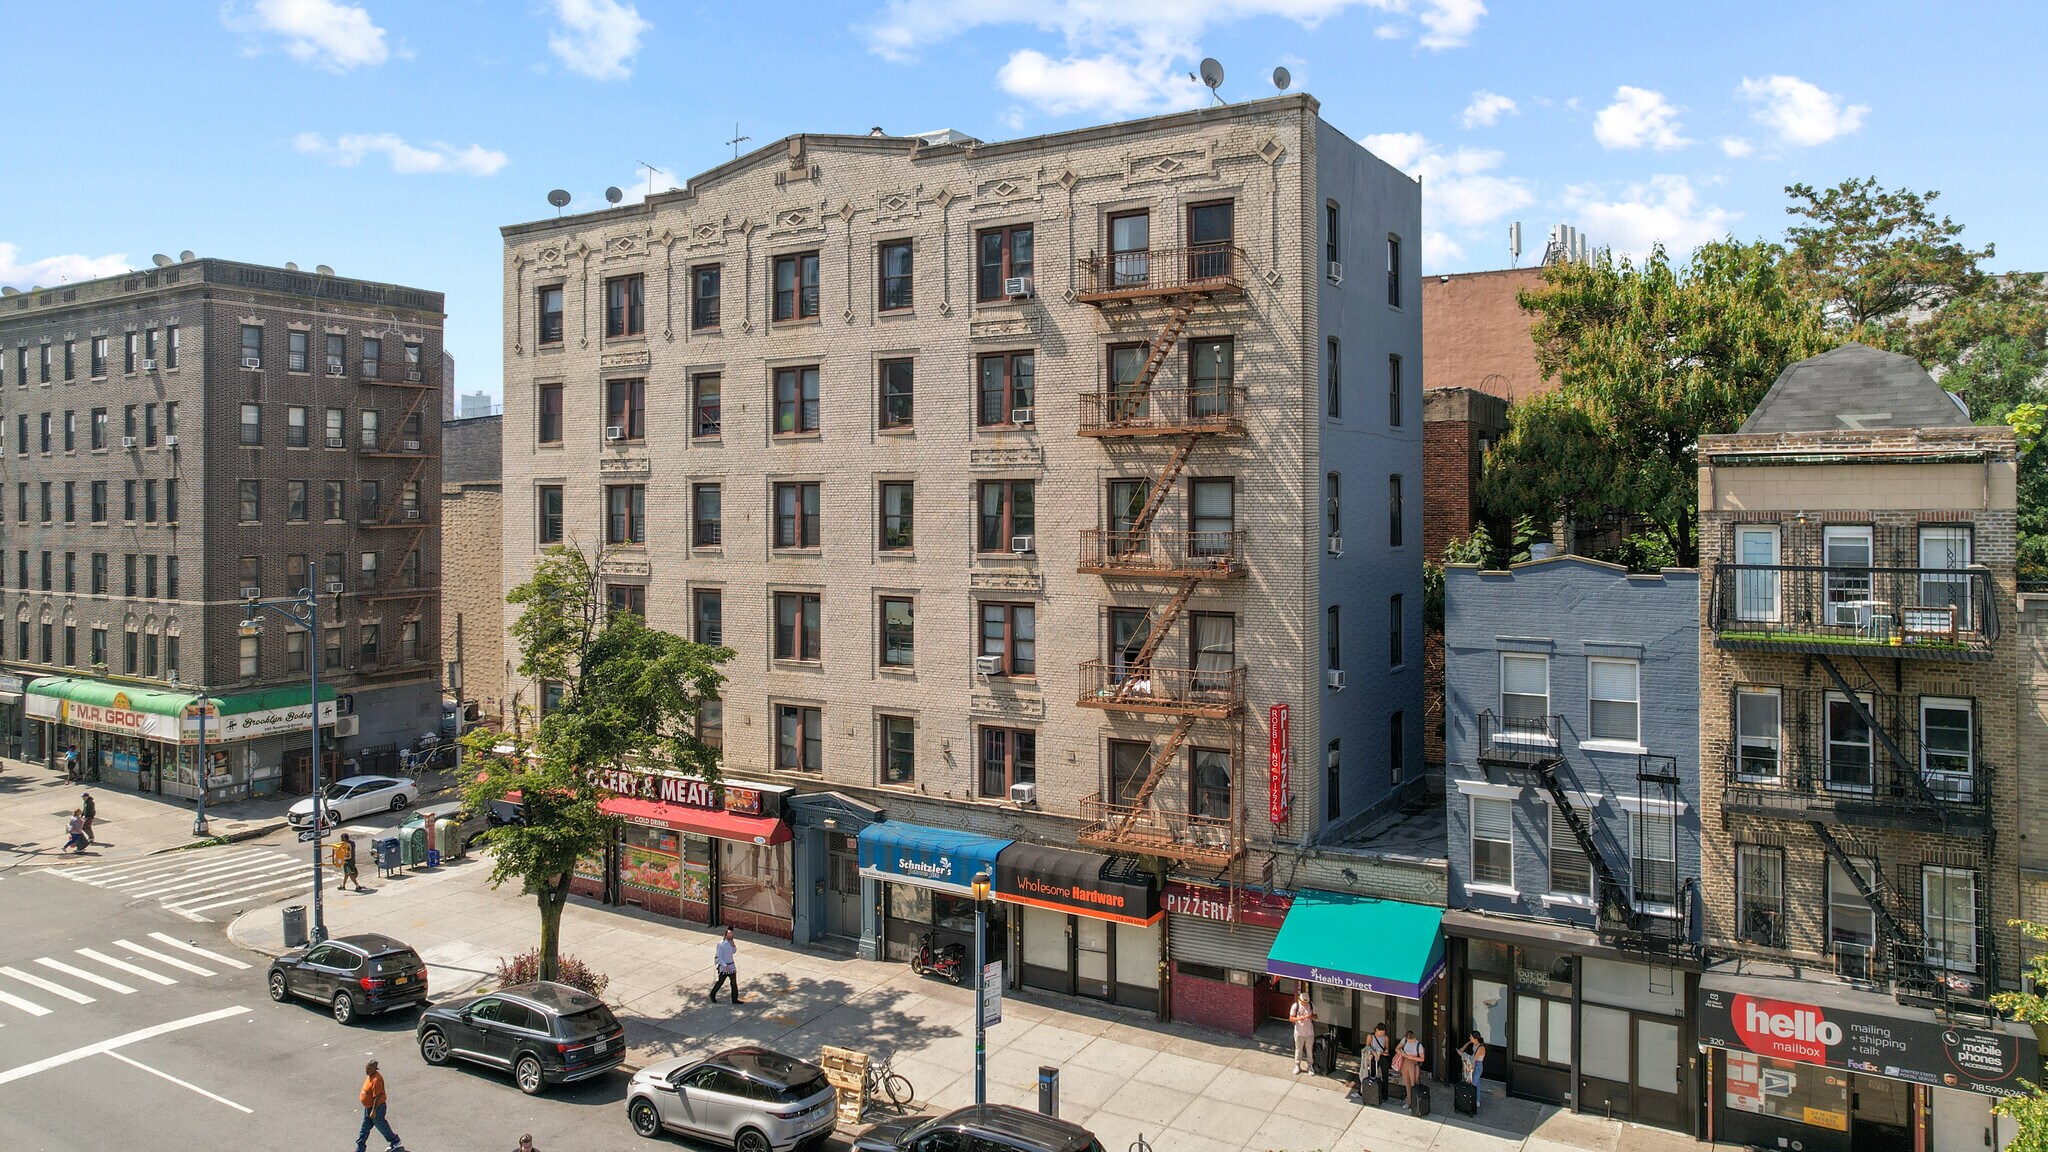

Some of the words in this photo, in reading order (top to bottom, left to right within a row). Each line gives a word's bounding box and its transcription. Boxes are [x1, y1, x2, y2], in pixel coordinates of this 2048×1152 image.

[77, 704, 102, 722] M.R.
[242, 716, 283, 729] Brooklyn
[285, 711, 314, 723] Bodeg
[1280, 709, 1288, 810] PIZZA
[586, 768, 638, 795] OCERY
[634, 816, 649, 824] COLD
[650, 819, 669, 828] DRINKS
[1017, 875, 1070, 898] Wholesome
[1072, 886, 1124, 908] Hardware
[1518, 970, 1533, 978] OUT
[1315, 973, 1343, 986] Health
[1346, 978, 1373, 991] Direct
[1746, 1002, 1843, 1046] hello
[1851, 1023, 1891, 1039] mailing
[1709, 1037, 1724, 1046] 320
[1859, 1034, 1906, 1052] shipping
[1773, 1042, 1821, 1057] mailbox
[1859, 1046, 1880, 1057] talk
[1962, 1043, 2002, 1056] mobile
[1847, 1058, 1879, 1073] FedEx
[1958, 1051, 2002, 1066] phones
[1964, 1062, 2003, 1073] ACCESSORIES
[1900, 1072, 1917, 1080] POSTAL
[1918, 1075, 1938, 1083] SERVICE
